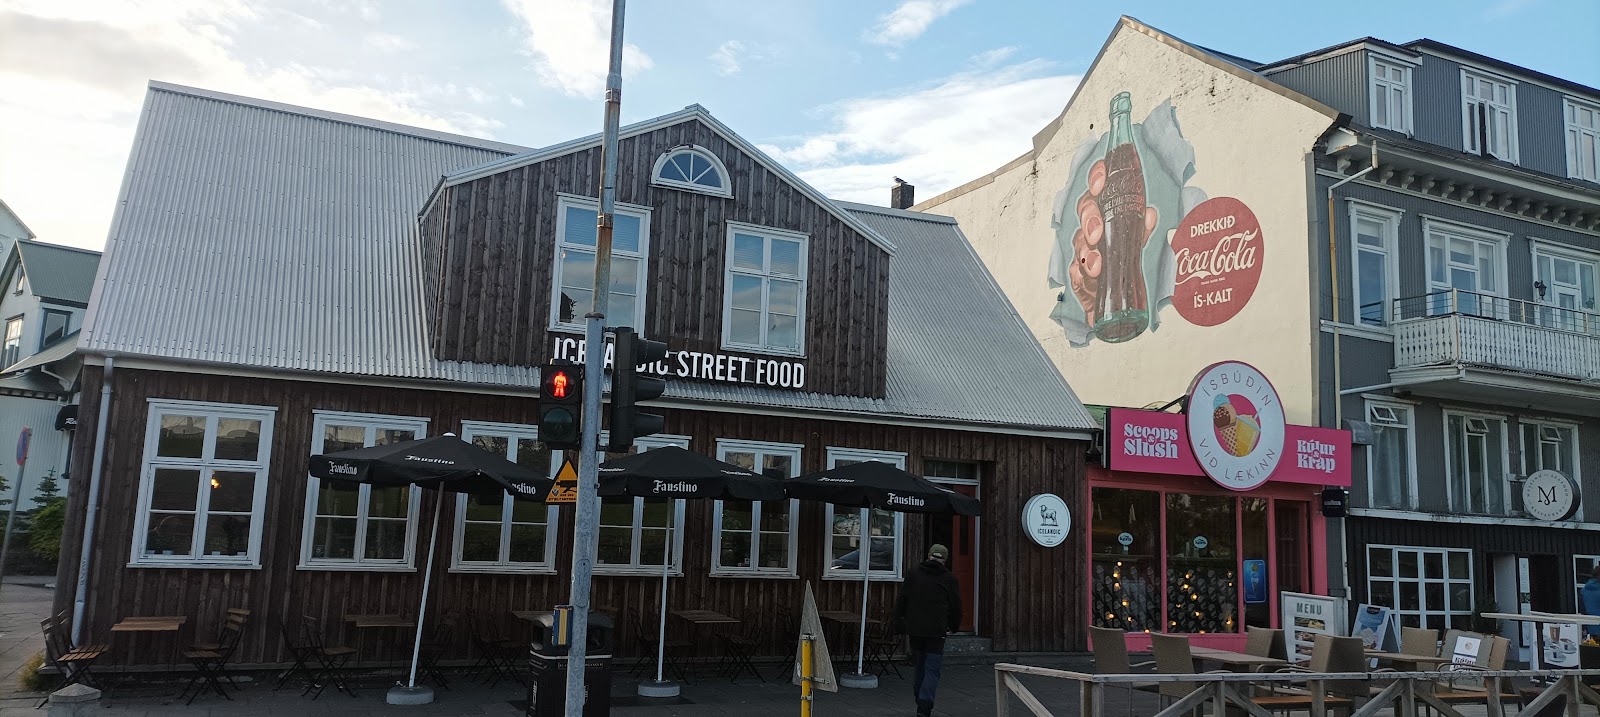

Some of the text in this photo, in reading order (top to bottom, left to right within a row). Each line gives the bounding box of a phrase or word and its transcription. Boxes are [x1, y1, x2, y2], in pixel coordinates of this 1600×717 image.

[1190, 215, 1236, 238] DREKKIÐ
[1175, 228, 1258, 285] Coca-Cola
[1193, 287, 1233, 309] ÍS-KALT
[676, 350, 749, 384] STREET
[755, 358, 806, 388] FOOD
[1123, 423, 1179, 442] Scoops
[1147, 435, 1155, 443] &
[1123, 438, 1179, 459] Slush
[1297, 439, 1336, 456] Kúlur
[328, 460, 358, 476] Faustino
[405, 454, 455, 465] Faustino
[1199, 438, 1275, 482] VIÐ LÆKINN
[1297, 453, 1336, 473] Krap
[652, 480, 699, 494] Faustino
[886, 492, 925, 507] Faustino
[1296, 602, 1322, 615] MENU
